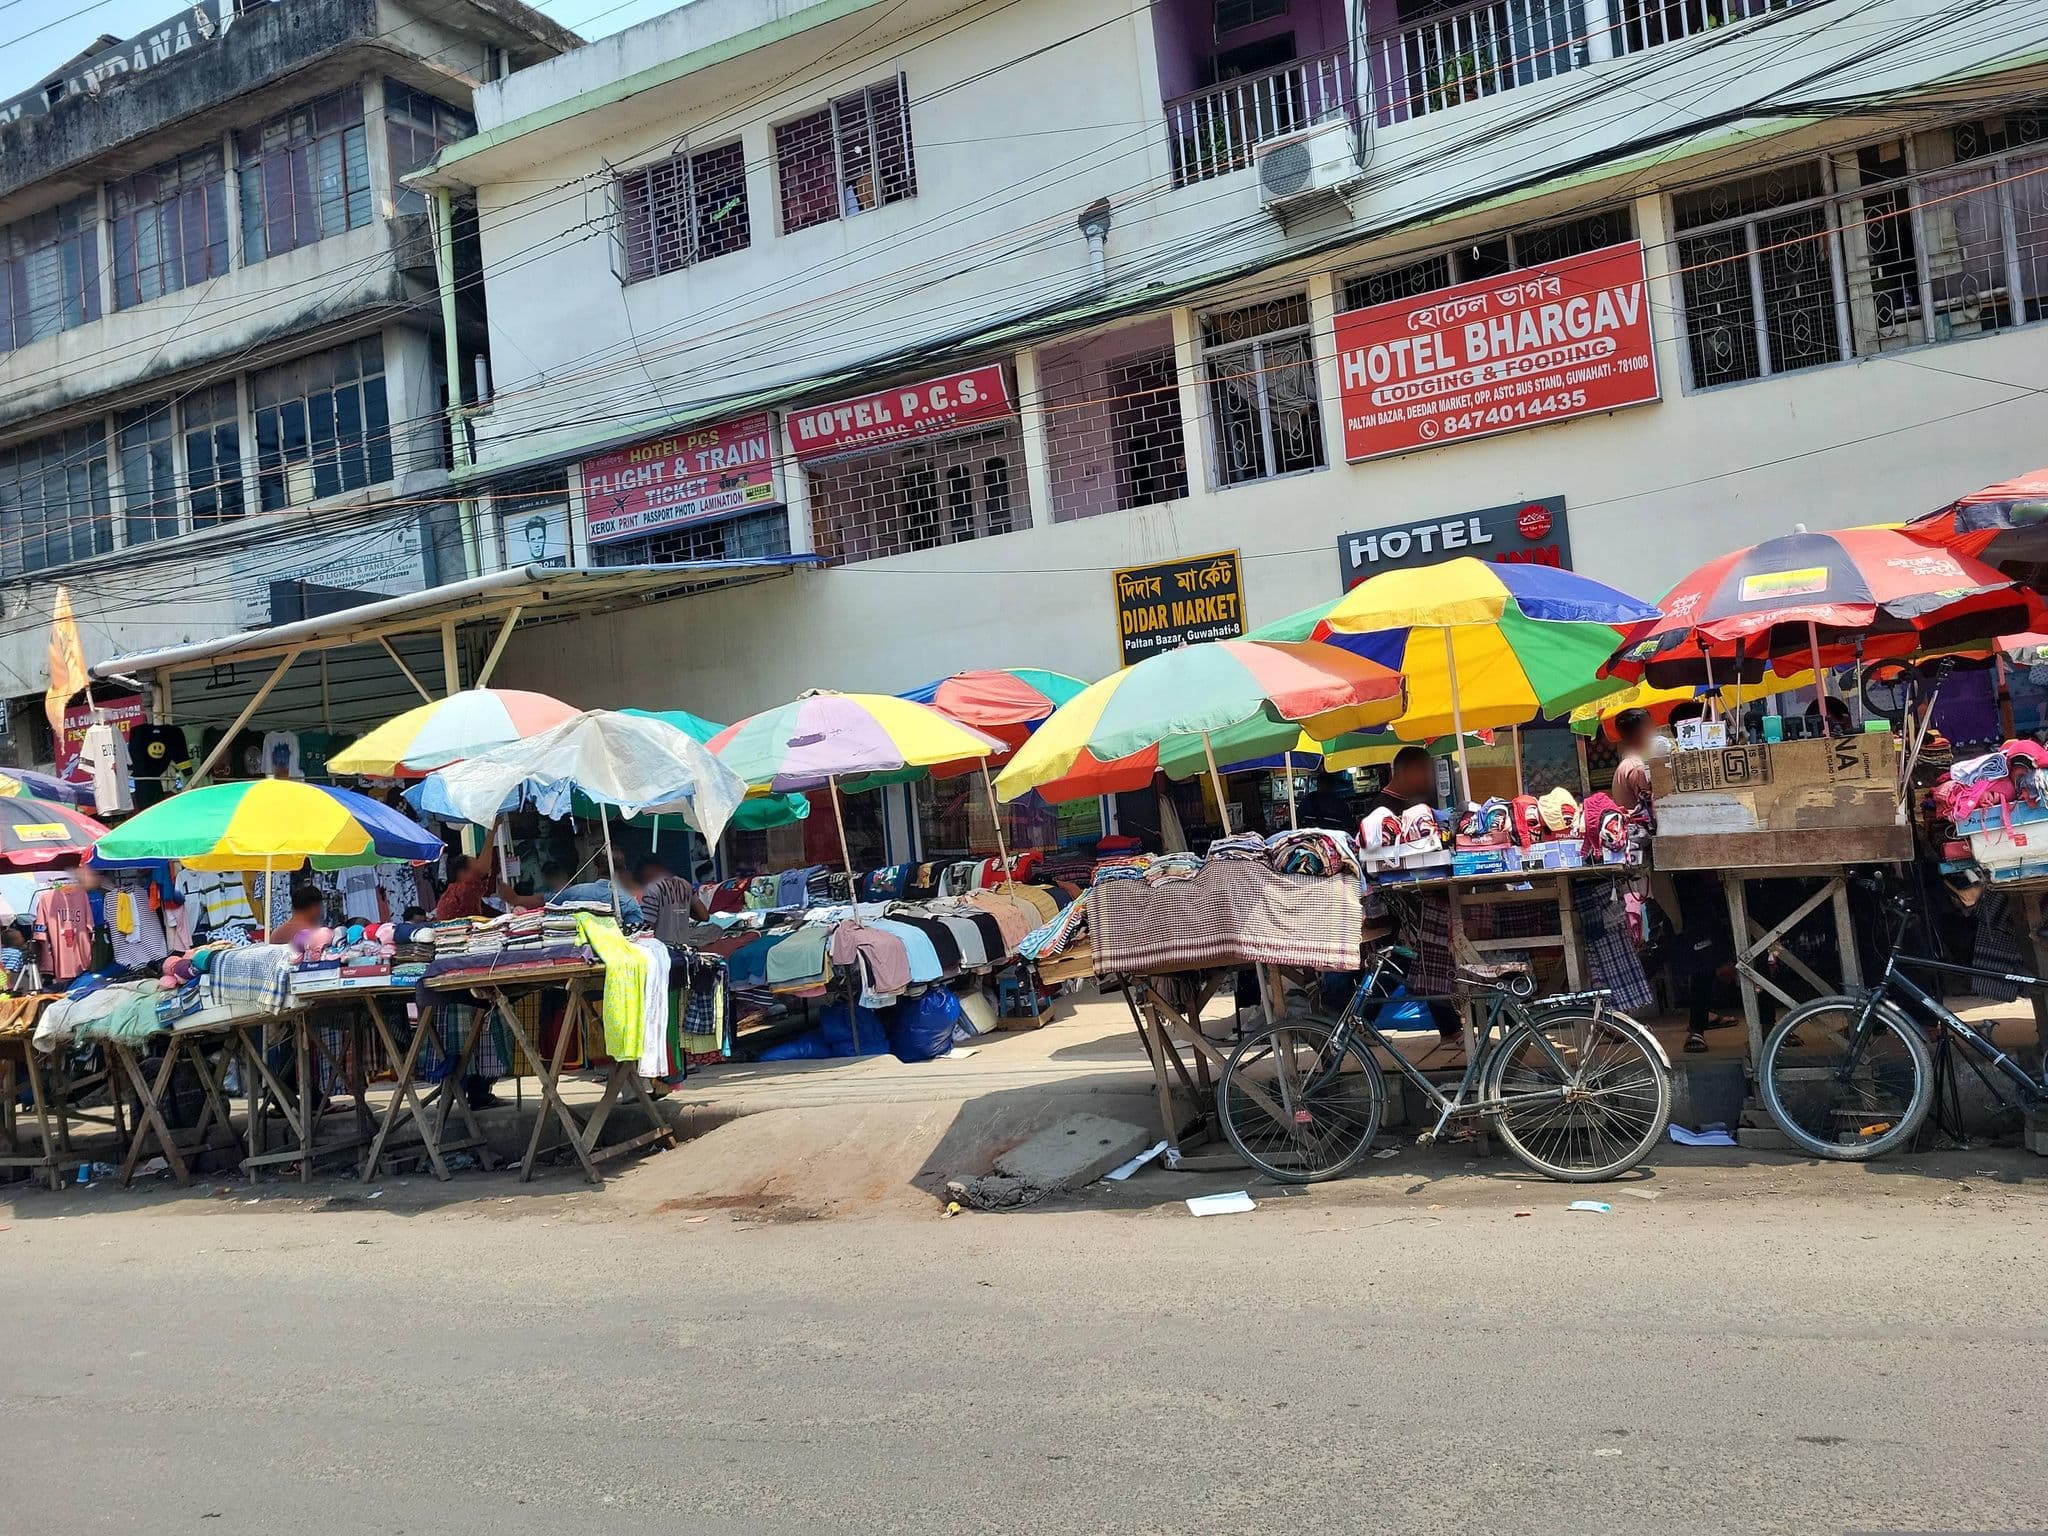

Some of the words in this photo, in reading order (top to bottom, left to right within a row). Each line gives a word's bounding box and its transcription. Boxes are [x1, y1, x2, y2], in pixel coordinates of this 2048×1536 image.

[1341, 334, 1455, 390] HOTEL
[1464, 283, 1641, 362] BHARGAV
[1348, 413, 1377, 431] PALTAN
[1378, 409, 1406, 425] BAZAR,
[1407, 402, 1437, 419] DEEDAR
[1439, 394, 1473, 413] MARKET,
[1474, 389, 1492, 404] OPP.
[1493, 384, 1515, 401] ASTC
[1516, 379, 1533, 395] BUS
[1535, 374, 1565, 392] STAND,
[1566, 362, 1612, 384] GUWAHATI
[1617, 354, 1649, 373] 781008
[1379, 371, 1474, 403] LODGING
[1483, 366, 1498, 381] &
[1505, 340, 1609, 376] FOODING
[798, 400, 893, 440] HOTEL
[900, 378, 988, 418] P.C.S.
[914, 411, 957, 433] ONLY
[1444, 388, 1587, 434] 8474014435
[590, 461, 665, 499] FLIGHT
[674, 457, 688, 479] &
[695, 437, 766, 472] TRAIN
[629, 438, 683, 465] HOTEL
[687, 429, 721, 451] PCS
[590, 519, 616, 537] XEROX
[618, 514, 639, 530] PRINT
[643, 507, 673, 524] PASSPORT
[675, 502, 696, 519] PHOTO
[700, 491, 744, 512] LAMINATION
[645, 478, 708, 506] TICKET
[1349, 517, 1493, 569] HOTEL
[309, 574, 325, 583] LED
[327, 567, 355, 580] LIGHTS
[364, 560, 395, 572] PANELS
[1122, 604, 1169, 635] DIDAR
[1172, 593, 1237, 627] MARKET
[1125, 638, 1154, 650] Paltan
[1156, 633, 1185, 646] Bazar,
[1187, 623, 1240, 641] Guwahati-8
[1943, 1016, 1976, 1040] ROCK
